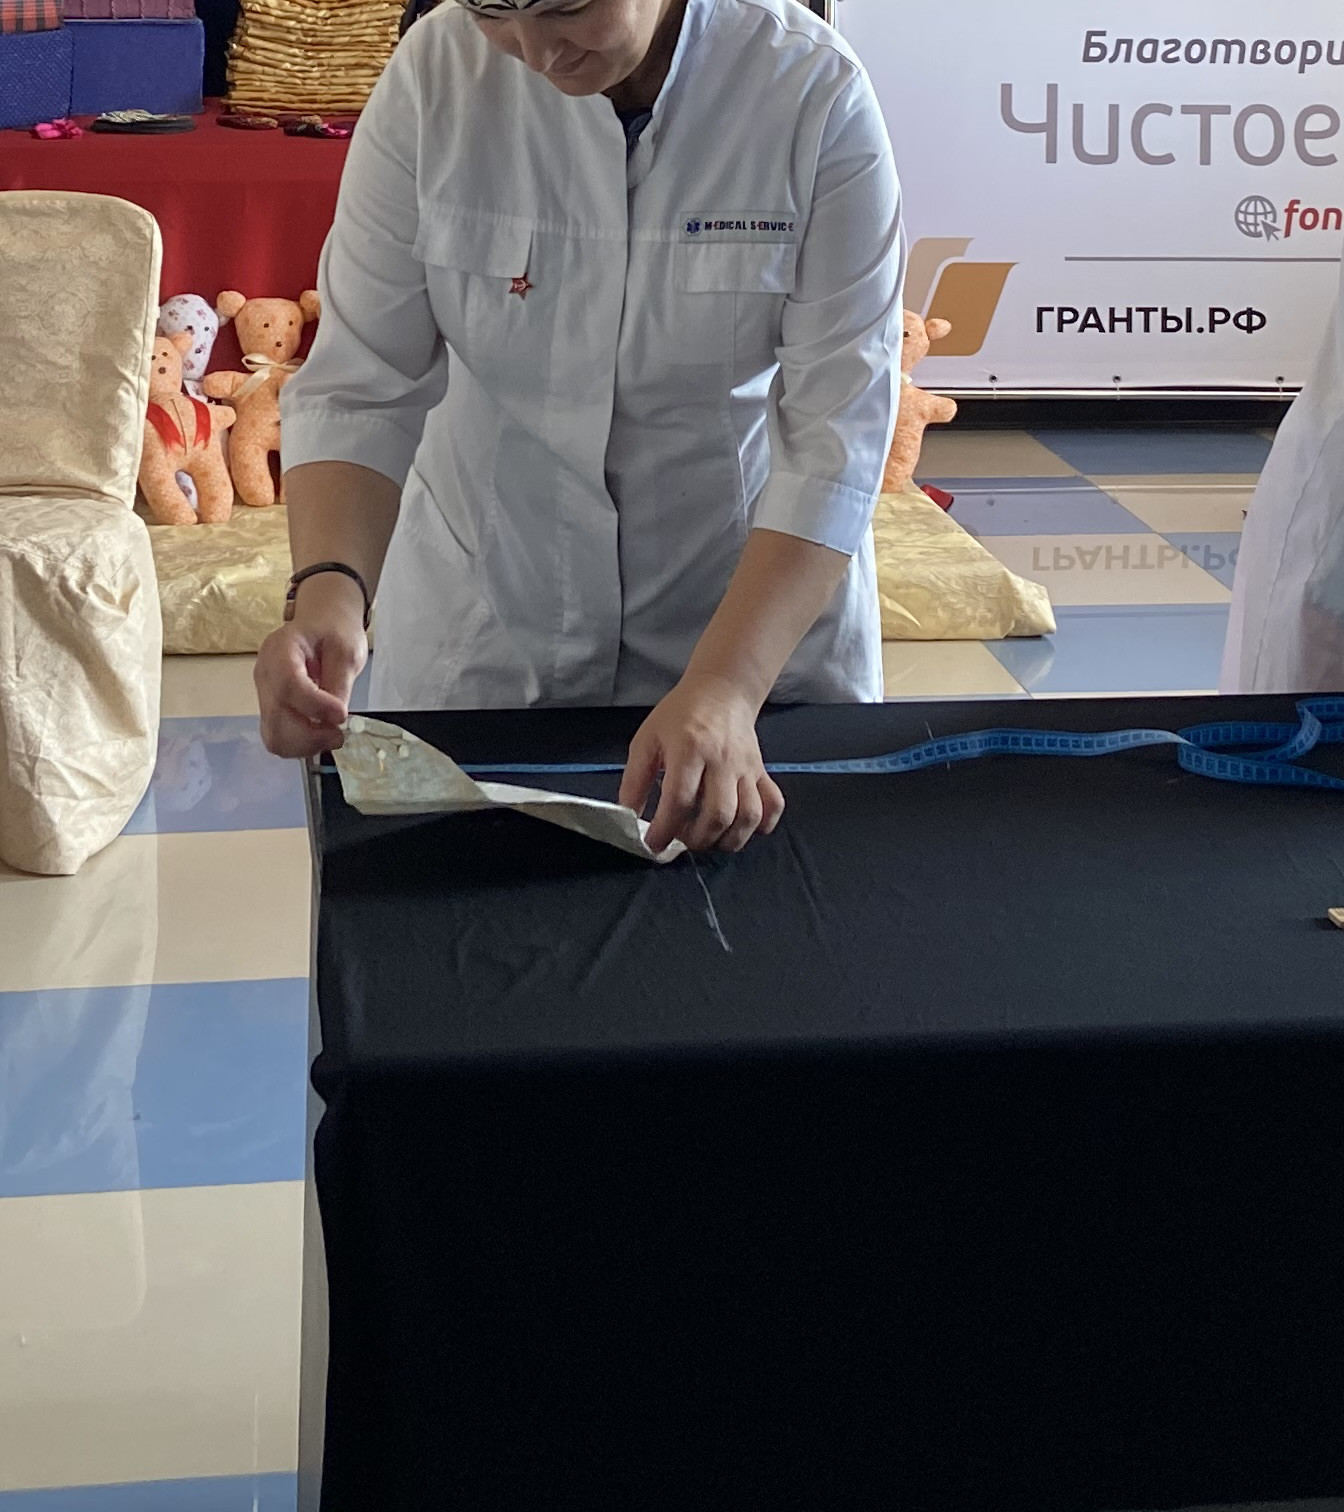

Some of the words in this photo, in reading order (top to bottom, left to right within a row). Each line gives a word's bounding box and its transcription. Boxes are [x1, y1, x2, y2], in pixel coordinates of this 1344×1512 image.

[1000, 82, 1341, 168] Чистое
[704, 220, 747, 231] MEDICAL
[750, 220, 795, 232] SERVICE
[1035, 305, 1267, 335] ГРАНТЫ.РФ
